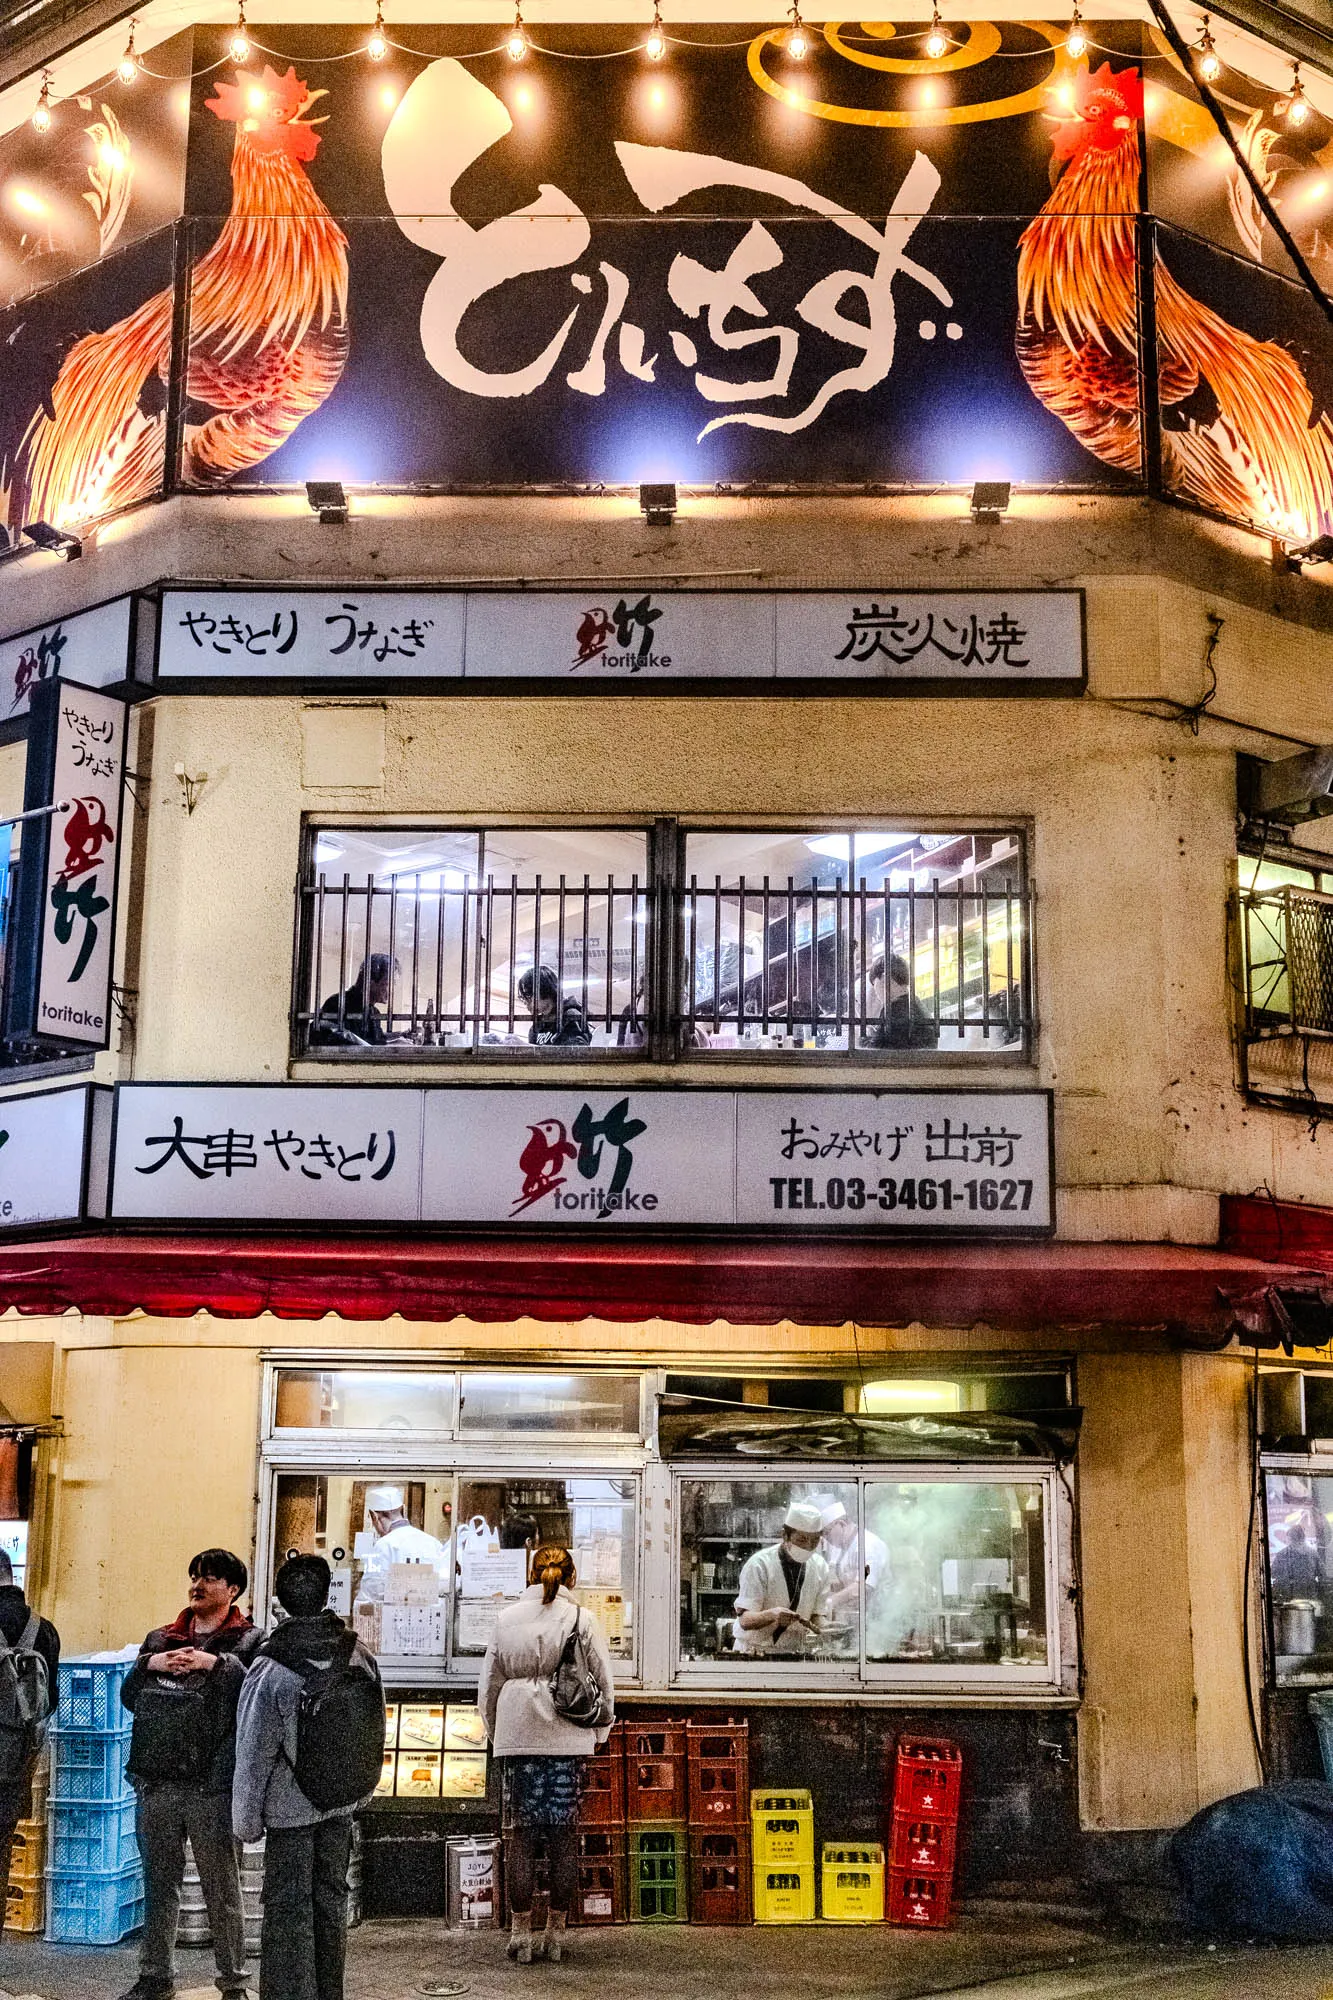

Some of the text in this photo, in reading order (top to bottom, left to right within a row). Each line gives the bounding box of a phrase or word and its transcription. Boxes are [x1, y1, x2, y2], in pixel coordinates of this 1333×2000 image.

[179, 603, 434, 663] やきとり うなぎ
[834, 603, 1031, 668] 炭火焼
[601, 653, 672, 668] toritake
[62, 707, 114, 744] やきとり
[72, 740, 118, 778] うなぎ
[41, 1001, 104, 1029] toritake
[781, 1117, 1022, 1167] おみやげ 出前
[554, 1187, 659, 1211] toritake
[769, 1177, 1034, 1211] TEL.03-3461-1627
